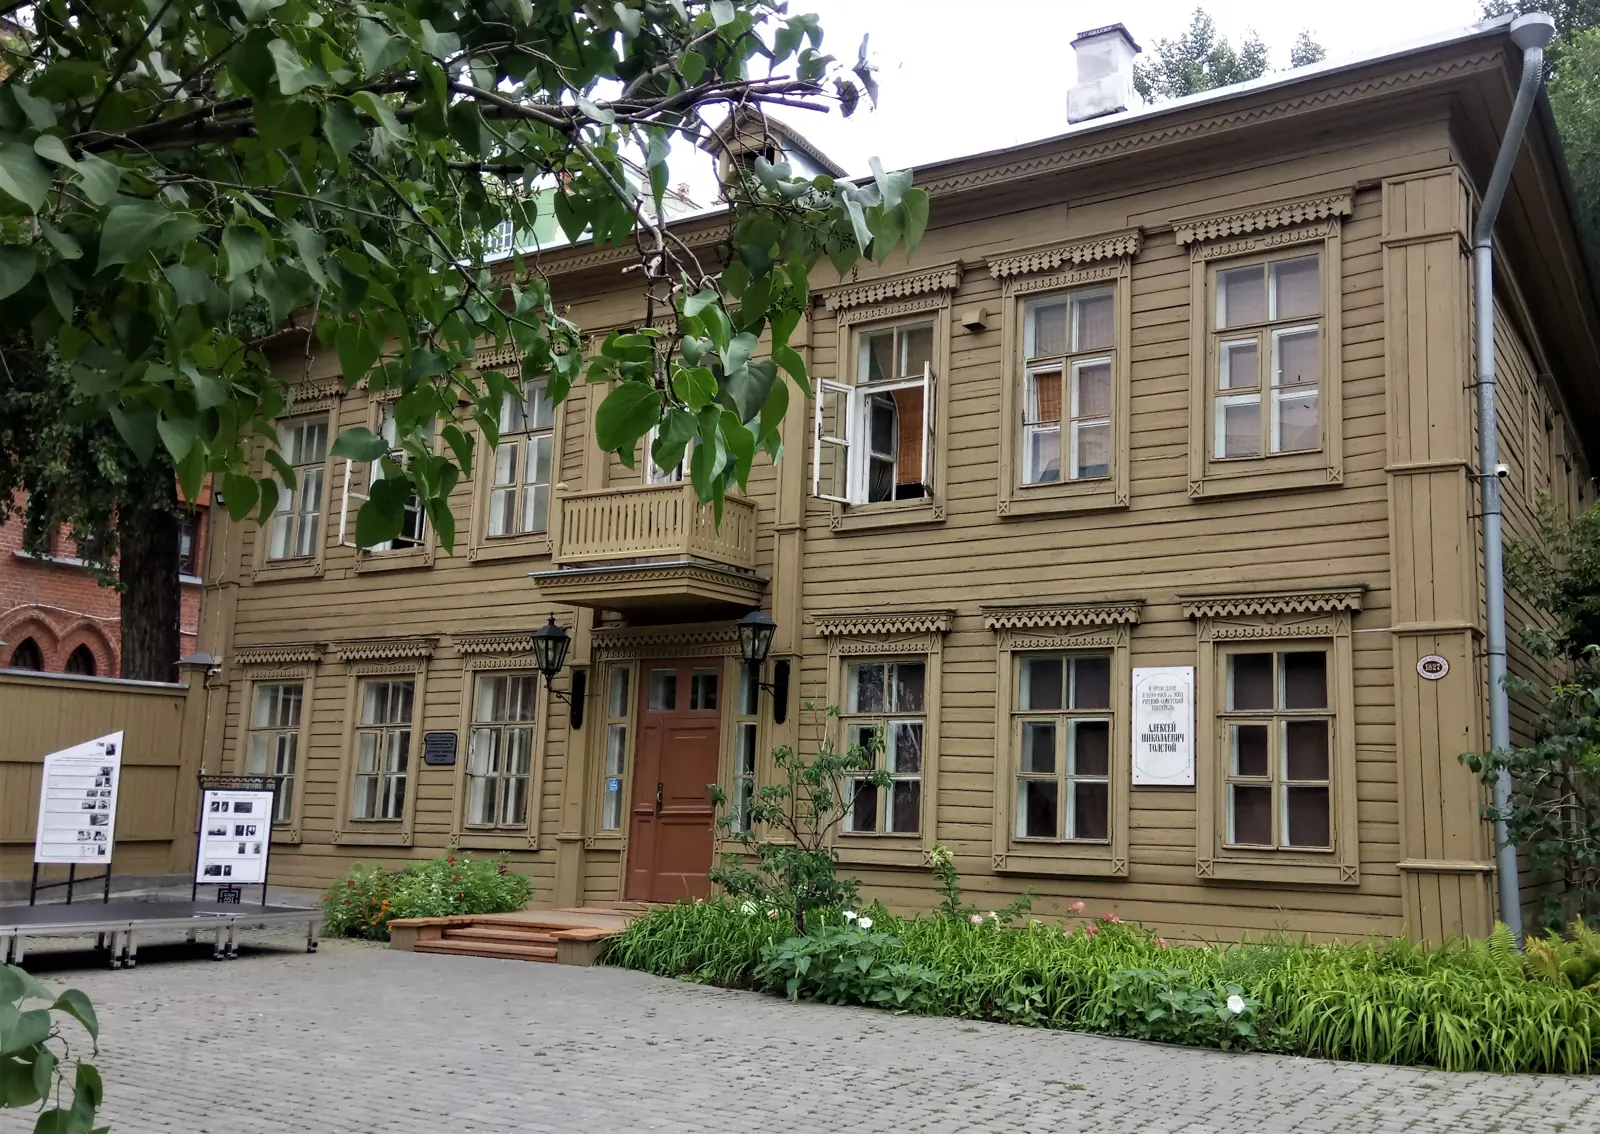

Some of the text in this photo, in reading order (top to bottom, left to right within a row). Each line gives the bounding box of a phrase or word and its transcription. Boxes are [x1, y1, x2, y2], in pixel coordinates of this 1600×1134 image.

[1425, 663, 1441, 671] 1827
[1148, 721, 1176, 733] АЛЕКСЕЙ
[1141, 733, 1185, 743] НИКОЛАЕВИЧ
[1148, 742, 1177, 753] ТОЛСТОЙ
